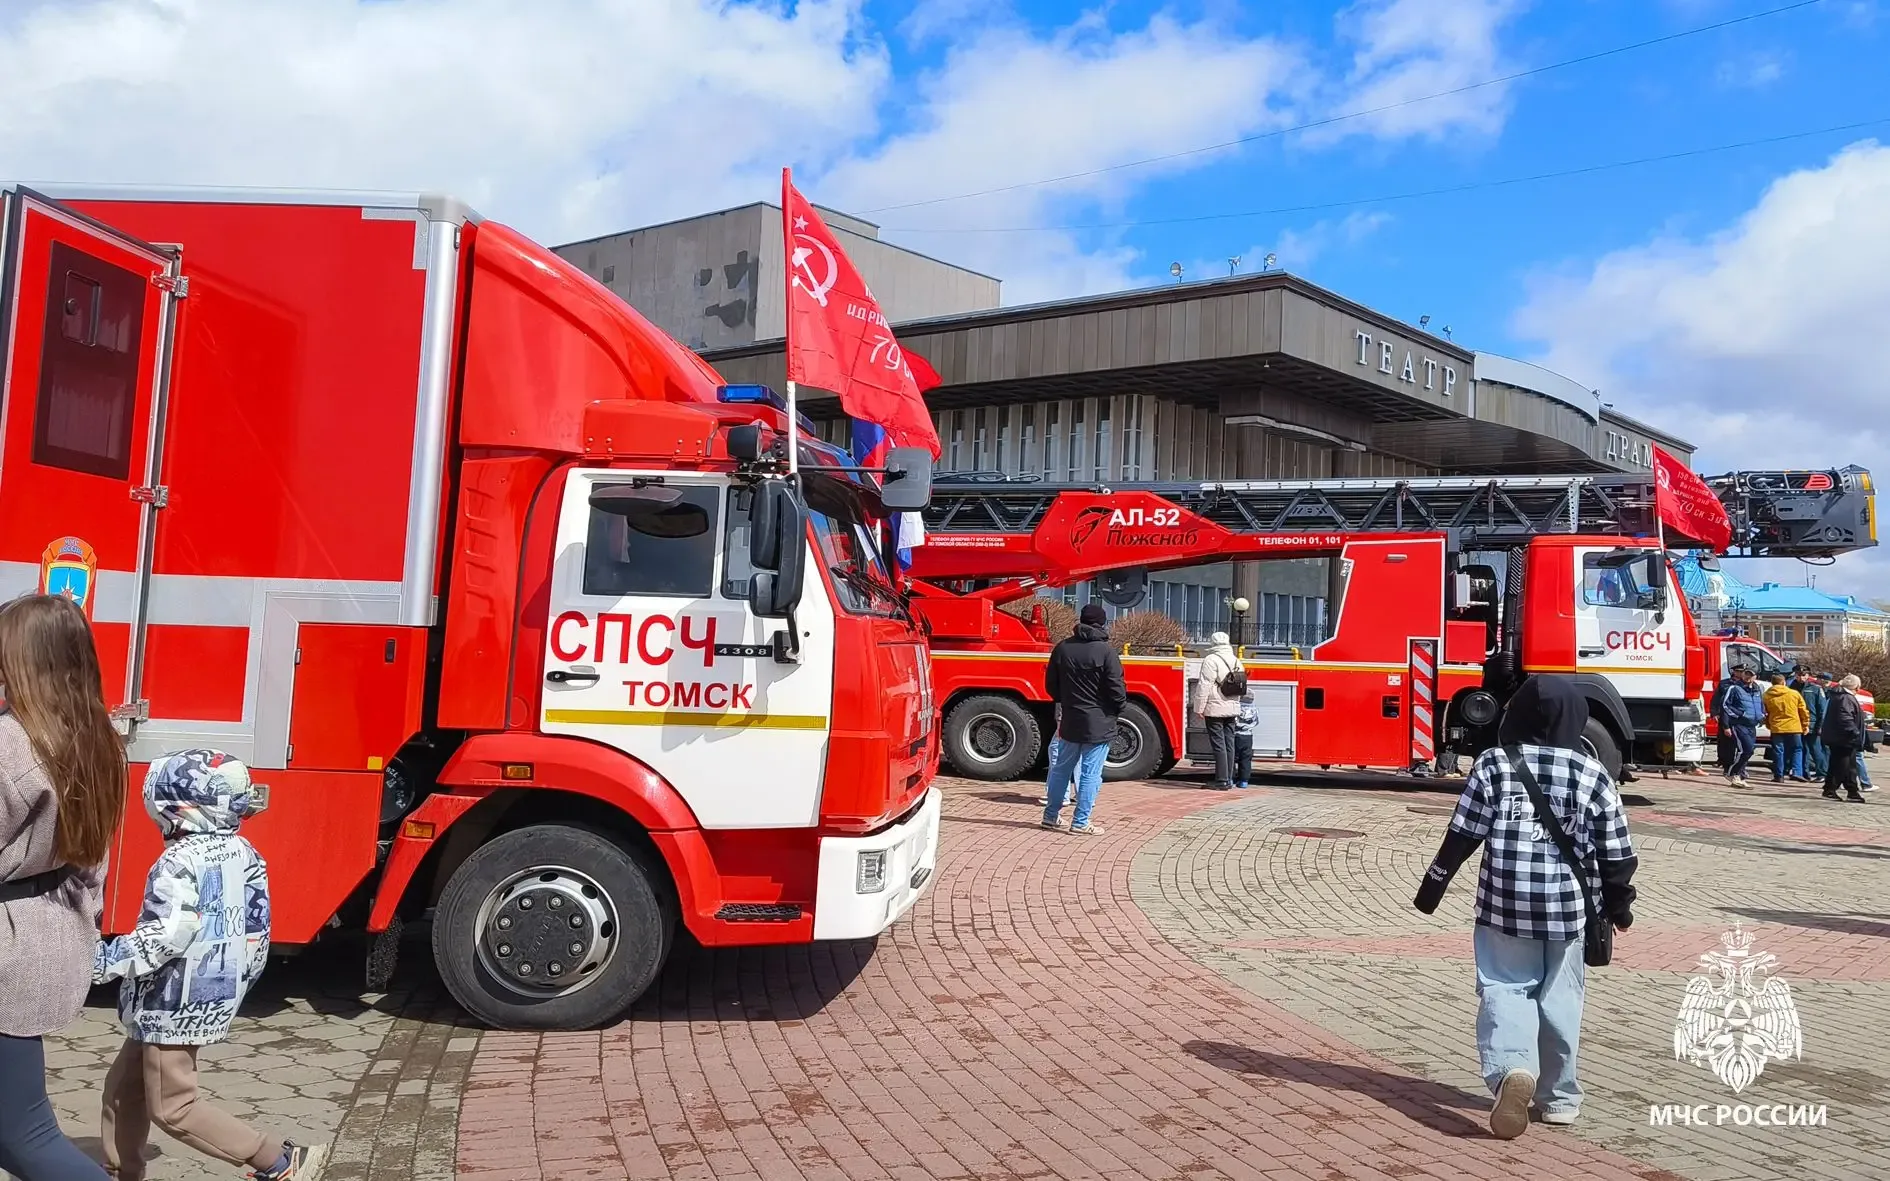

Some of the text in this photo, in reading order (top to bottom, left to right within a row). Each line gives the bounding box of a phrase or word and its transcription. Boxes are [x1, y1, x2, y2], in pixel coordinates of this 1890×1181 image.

[869, 334, 900, 370] 79
[1355, 328, 1457, 397] ТЕАТР
[1108, 508, 1180, 526] АЛ-52
[1258, 536, 1341, 546] ТЕЛЕФОН 01, 101
[550, 611, 717, 667] СПСЧ
[1606, 630, 1670, 651] СПСЧ
[718, 647, 767, 656] 4308
[1625, 654, 1653, 662] ТОМСК
[623, 681, 752, 709] ТОМСК
[170, 995, 225, 1018] SKATE
